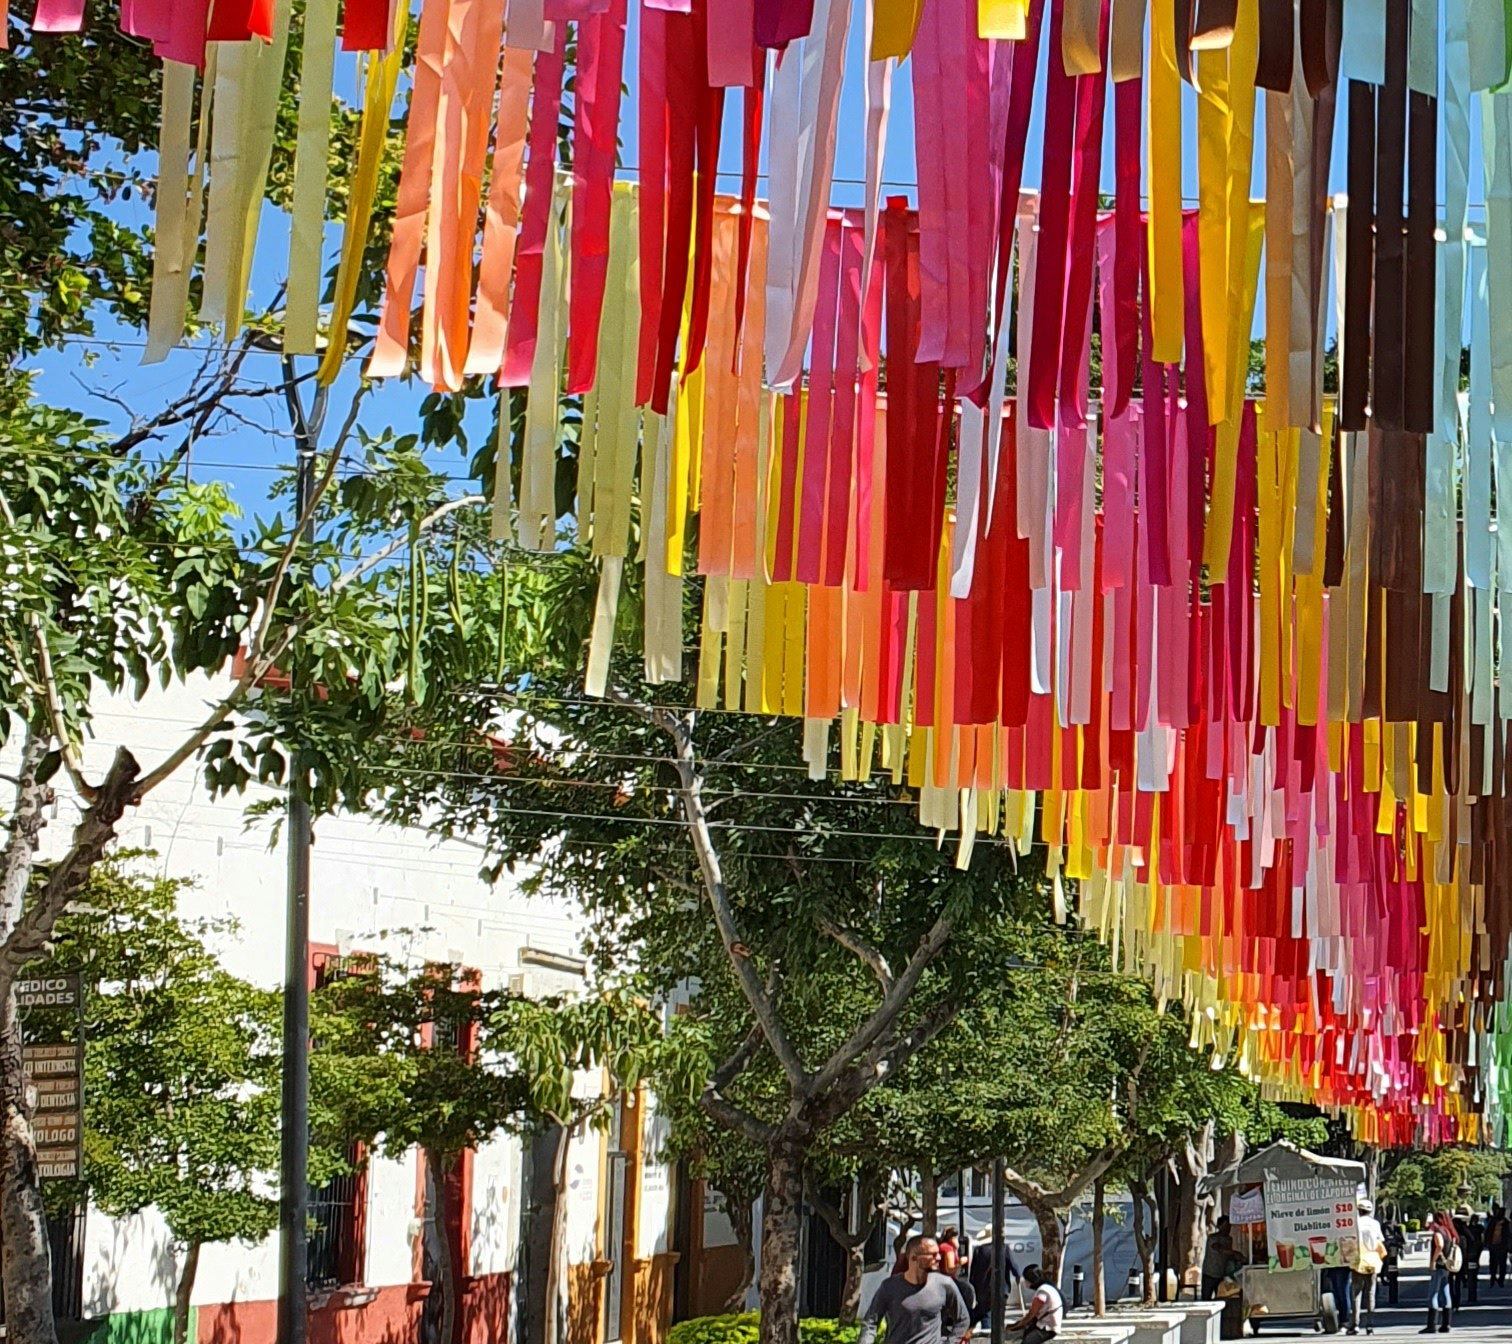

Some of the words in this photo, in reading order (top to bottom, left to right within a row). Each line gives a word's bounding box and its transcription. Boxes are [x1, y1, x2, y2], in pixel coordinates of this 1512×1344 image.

[19, 978, 67, 992] EDICO
[18, 992, 75, 1006] IDADES
[38, 1163, 76, 1178] TOLOGIA
[1271, 1209, 1294, 1219] Nieve
[1295, 1208, 1305, 1217] de
[1294, 1221, 1331, 1232] Diablitos
